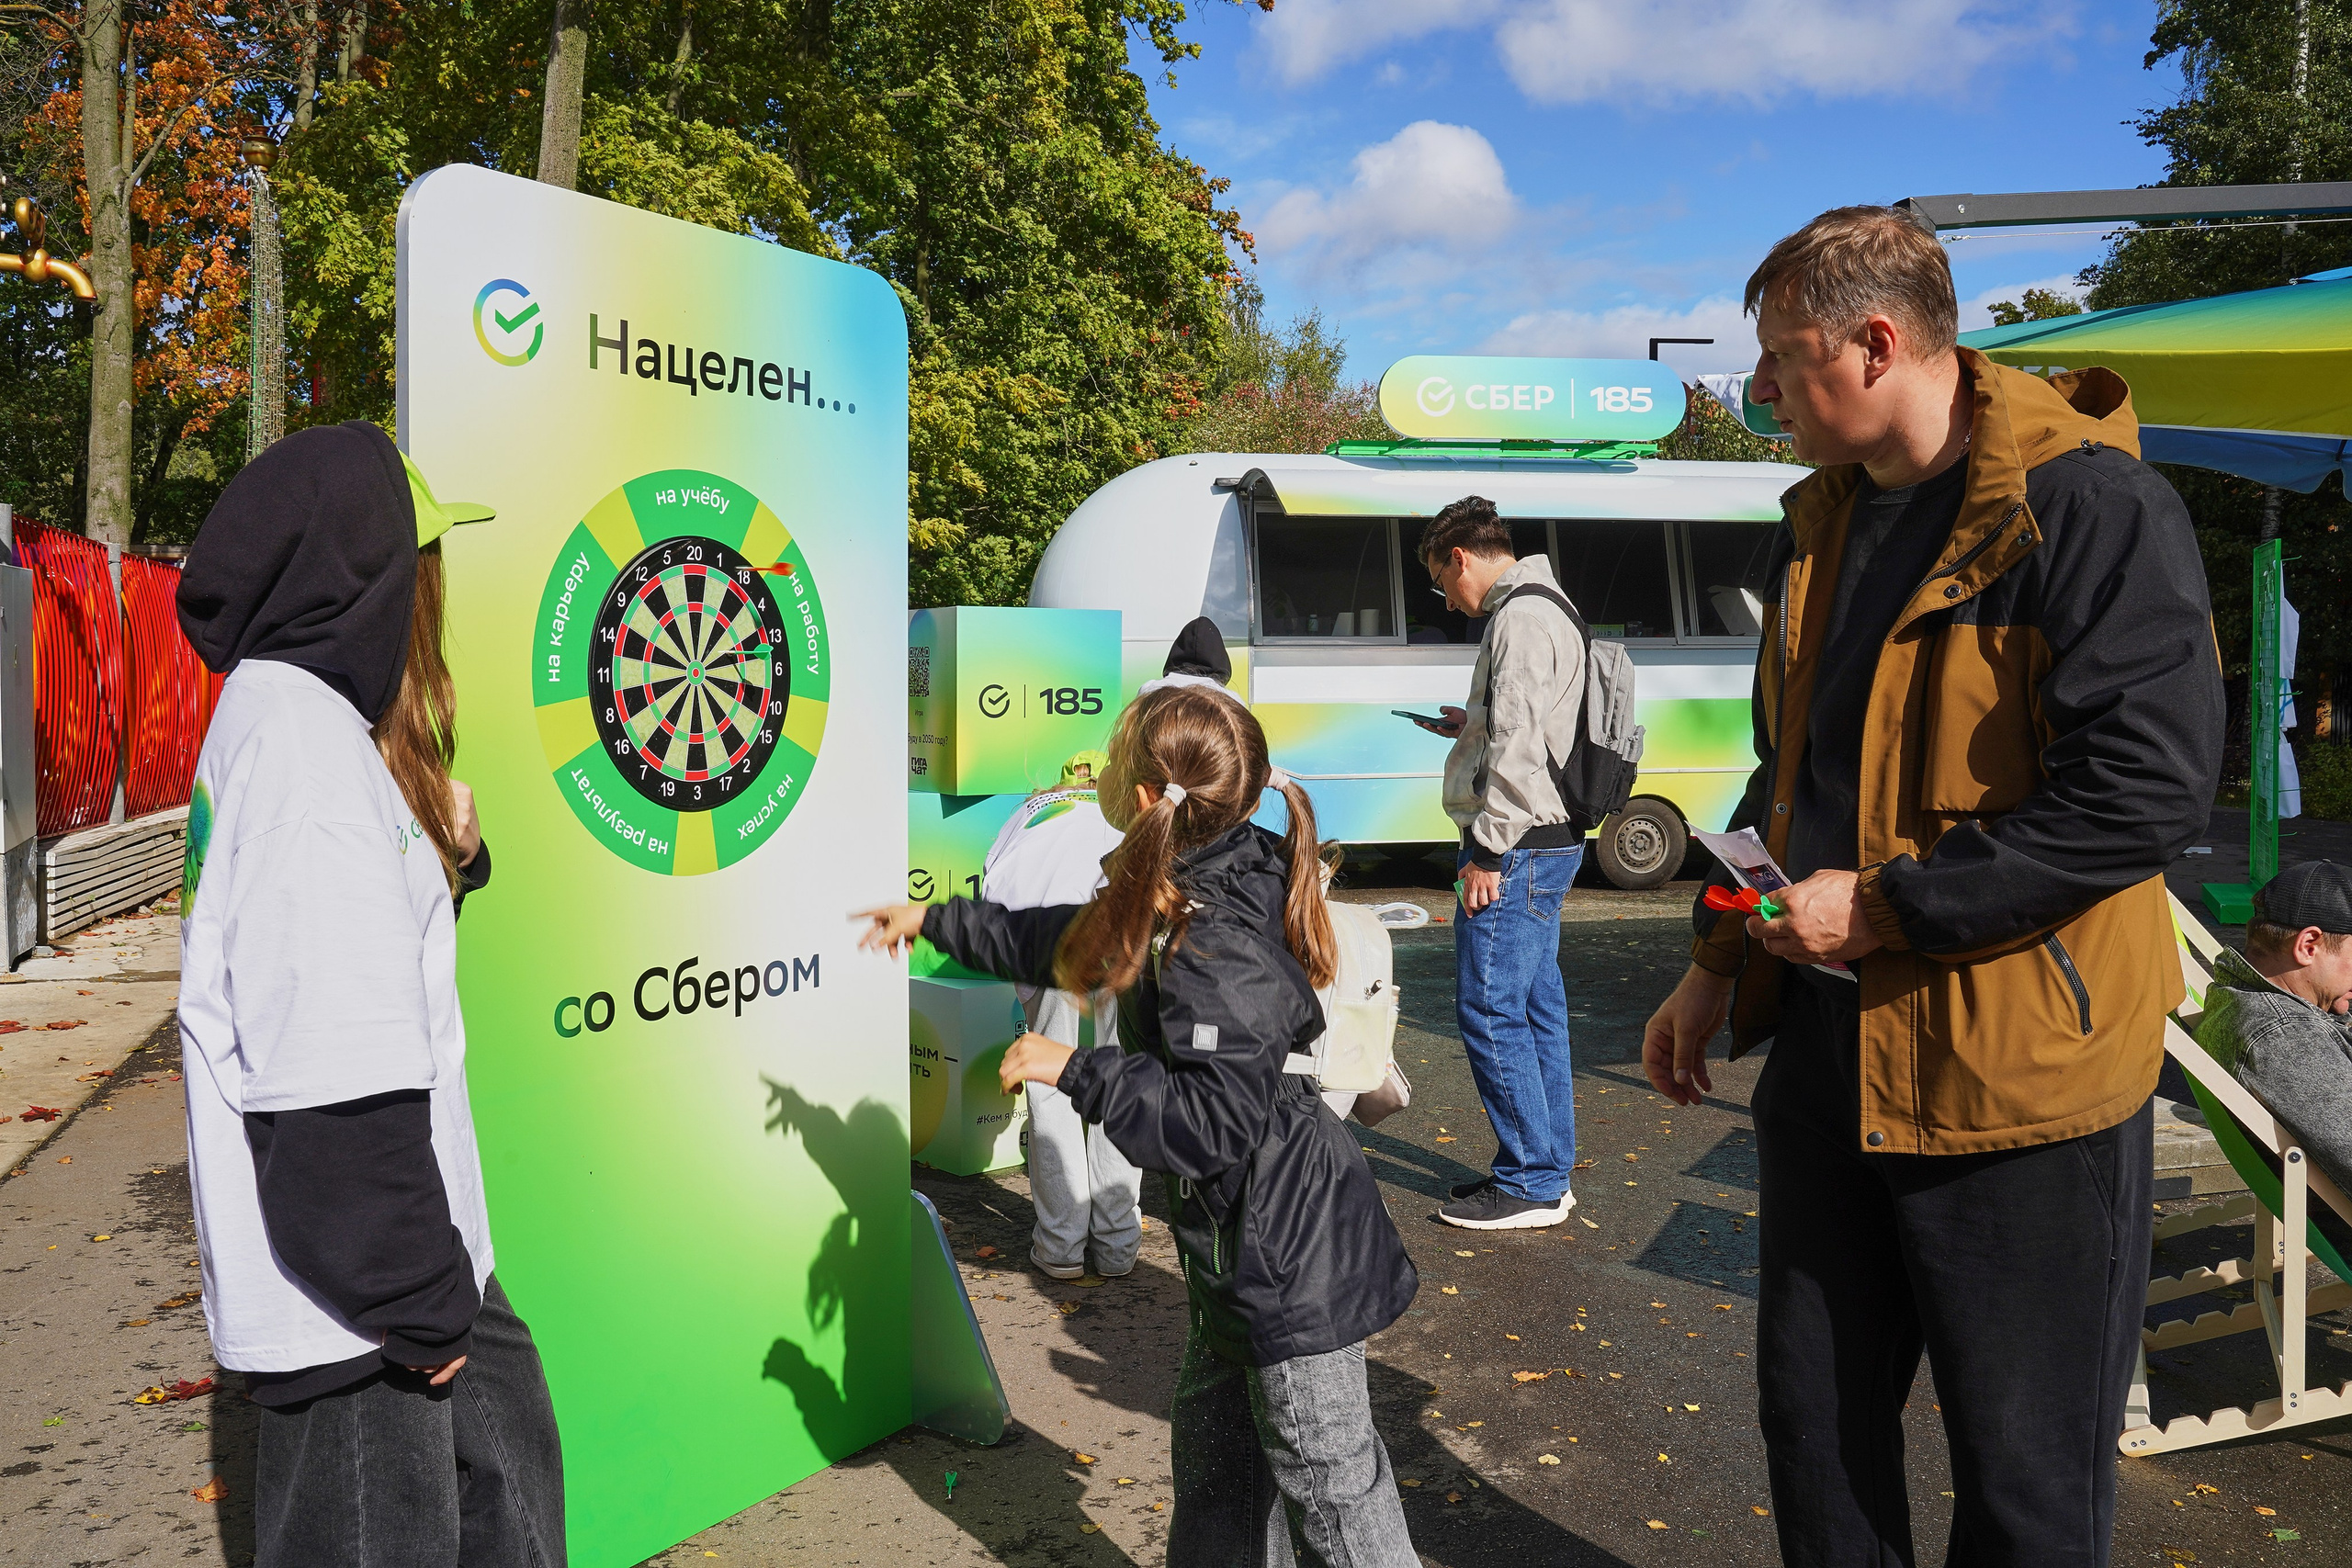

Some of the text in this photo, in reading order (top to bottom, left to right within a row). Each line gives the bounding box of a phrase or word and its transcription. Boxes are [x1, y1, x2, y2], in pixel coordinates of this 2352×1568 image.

[589, 312, 856, 415] Нацелен...
[1465, 384, 1654, 413] СБЕР 185
[655, 485, 730, 514] на учёбу
[662, 549, 672, 565] 5
[686, 545, 703, 561] 20
[717, 552, 723, 568] 1
[635, 566, 649, 581] 12
[737, 570, 751, 585] 18
[616, 592, 627, 607] 9
[757, 597, 766, 612] 4
[548, 551, 591, 682] на карьеру
[788, 571, 820, 675] на работу
[600, 626, 616, 643] 14
[768, 628, 782, 643] 13
[597, 667, 610, 683] 11
[775, 661, 783, 676] 6
[769, 700, 783, 716] 10
[1039, 687, 1103, 716] 185
[605, 707, 615, 723] 8
[760, 729, 773, 744] 15
[922, 734, 934, 744] 2050
[934, 736, 948, 747] году?
[615, 739, 630, 755] 16
[639, 764, 649, 780] 7
[742, 758, 751, 773] 2
[660, 781, 675, 796] 19
[718, 776, 733, 791] 17
[694, 785, 702, 800] 3
[571, 768, 669, 855] на результат
[737, 774, 794, 840] на успех
[553, 955, 820, 1039] со Сбером
[976, 1113, 1002, 1125] #Кем
[1012, 1108, 1028, 1120] буд
